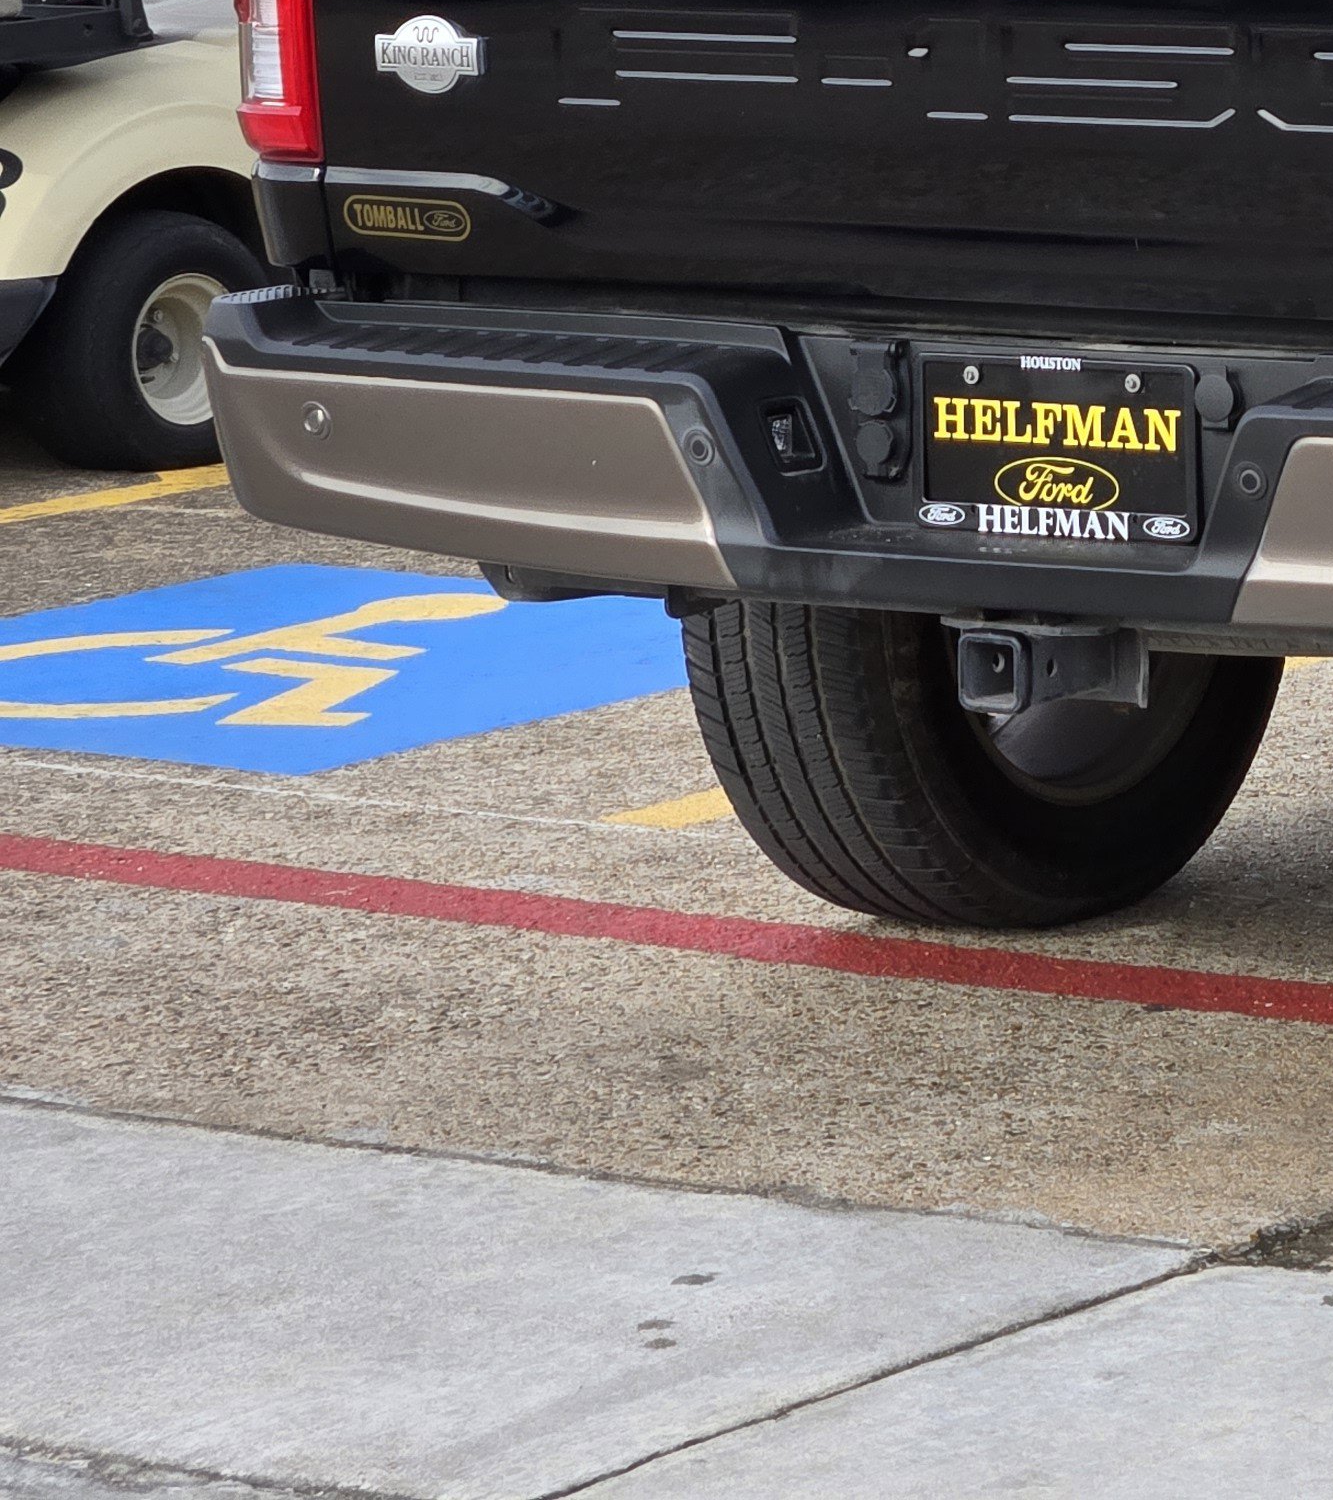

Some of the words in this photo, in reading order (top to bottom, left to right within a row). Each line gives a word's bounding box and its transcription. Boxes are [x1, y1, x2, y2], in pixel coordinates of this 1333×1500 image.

[380, 41, 418, 67] KING
[420, 44, 472, 69] RANCH
[352, 203, 425, 232] TOMBALL
[1020, 355, 1081, 372] HOUSTON
[933, 396, 1182, 452] HELFMAN
[1018, 463, 1094, 505] Ford
[977, 503, 1130, 541] HELFMAN
